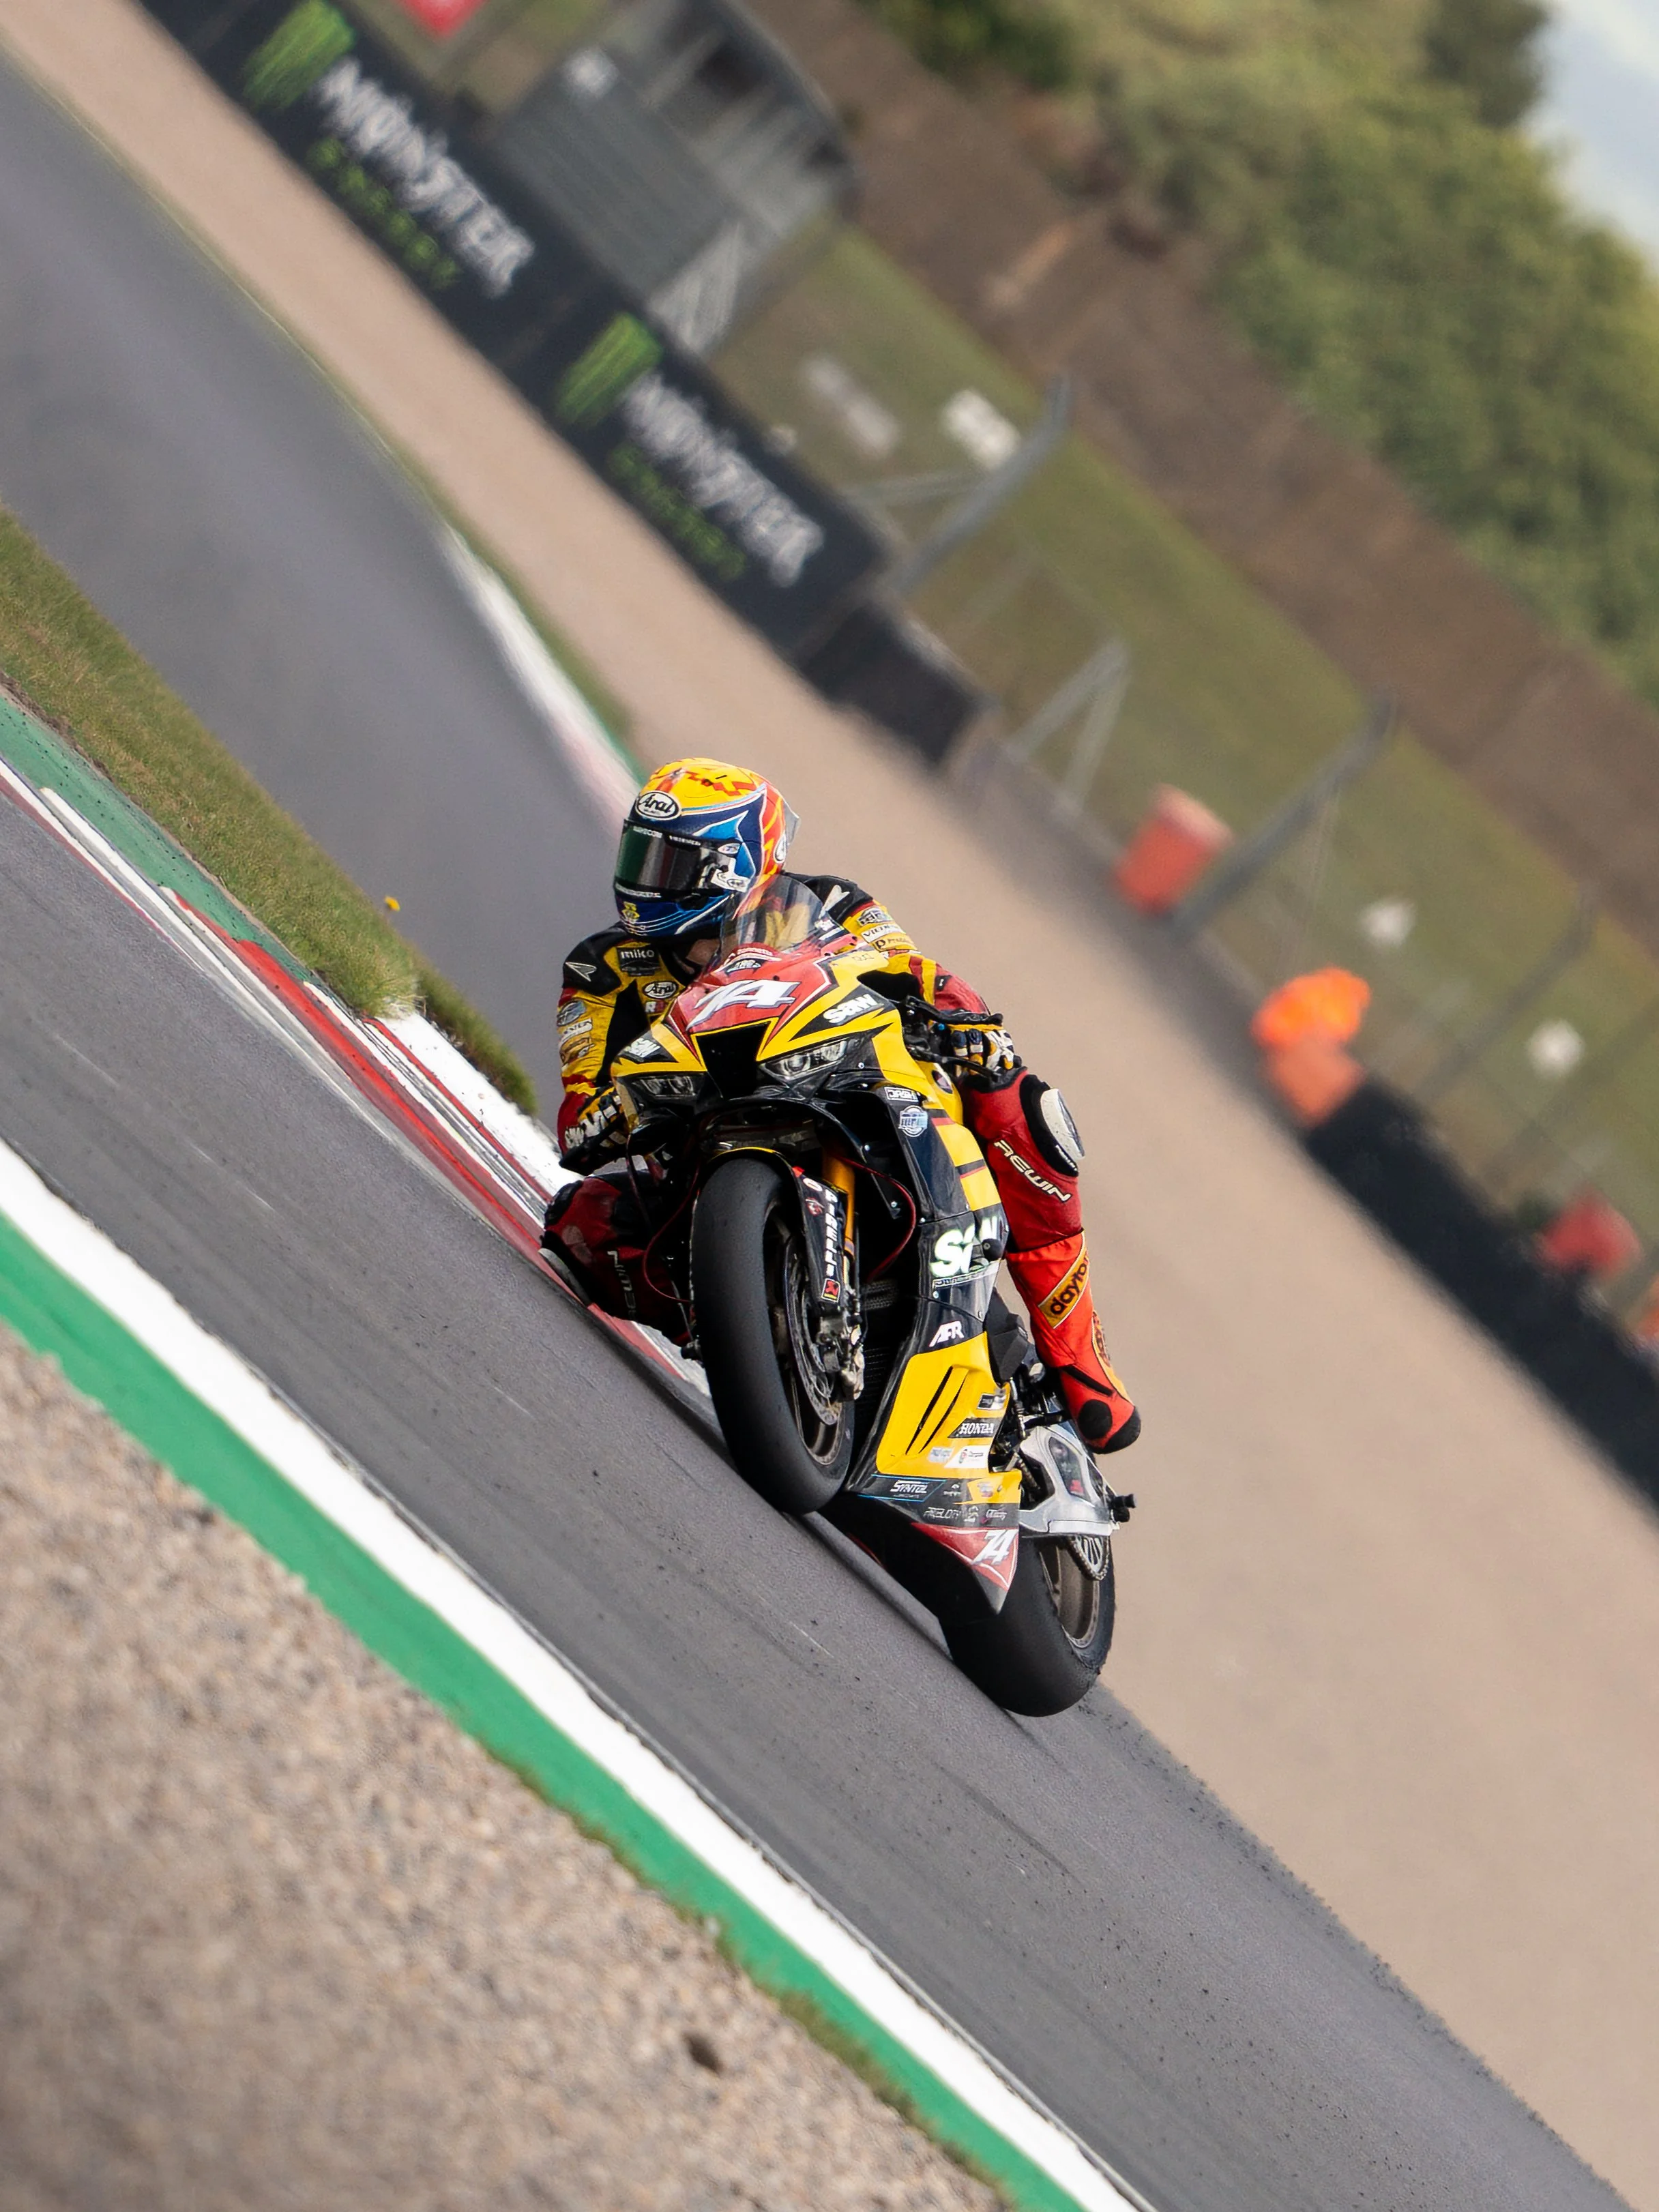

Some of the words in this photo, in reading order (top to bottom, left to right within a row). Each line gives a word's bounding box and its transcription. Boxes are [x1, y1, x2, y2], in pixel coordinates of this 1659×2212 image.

[686, 979, 801, 1031] 74
[825, 1188, 838, 1277] PIRELLI
[971, 1529, 1016, 1565] 74
